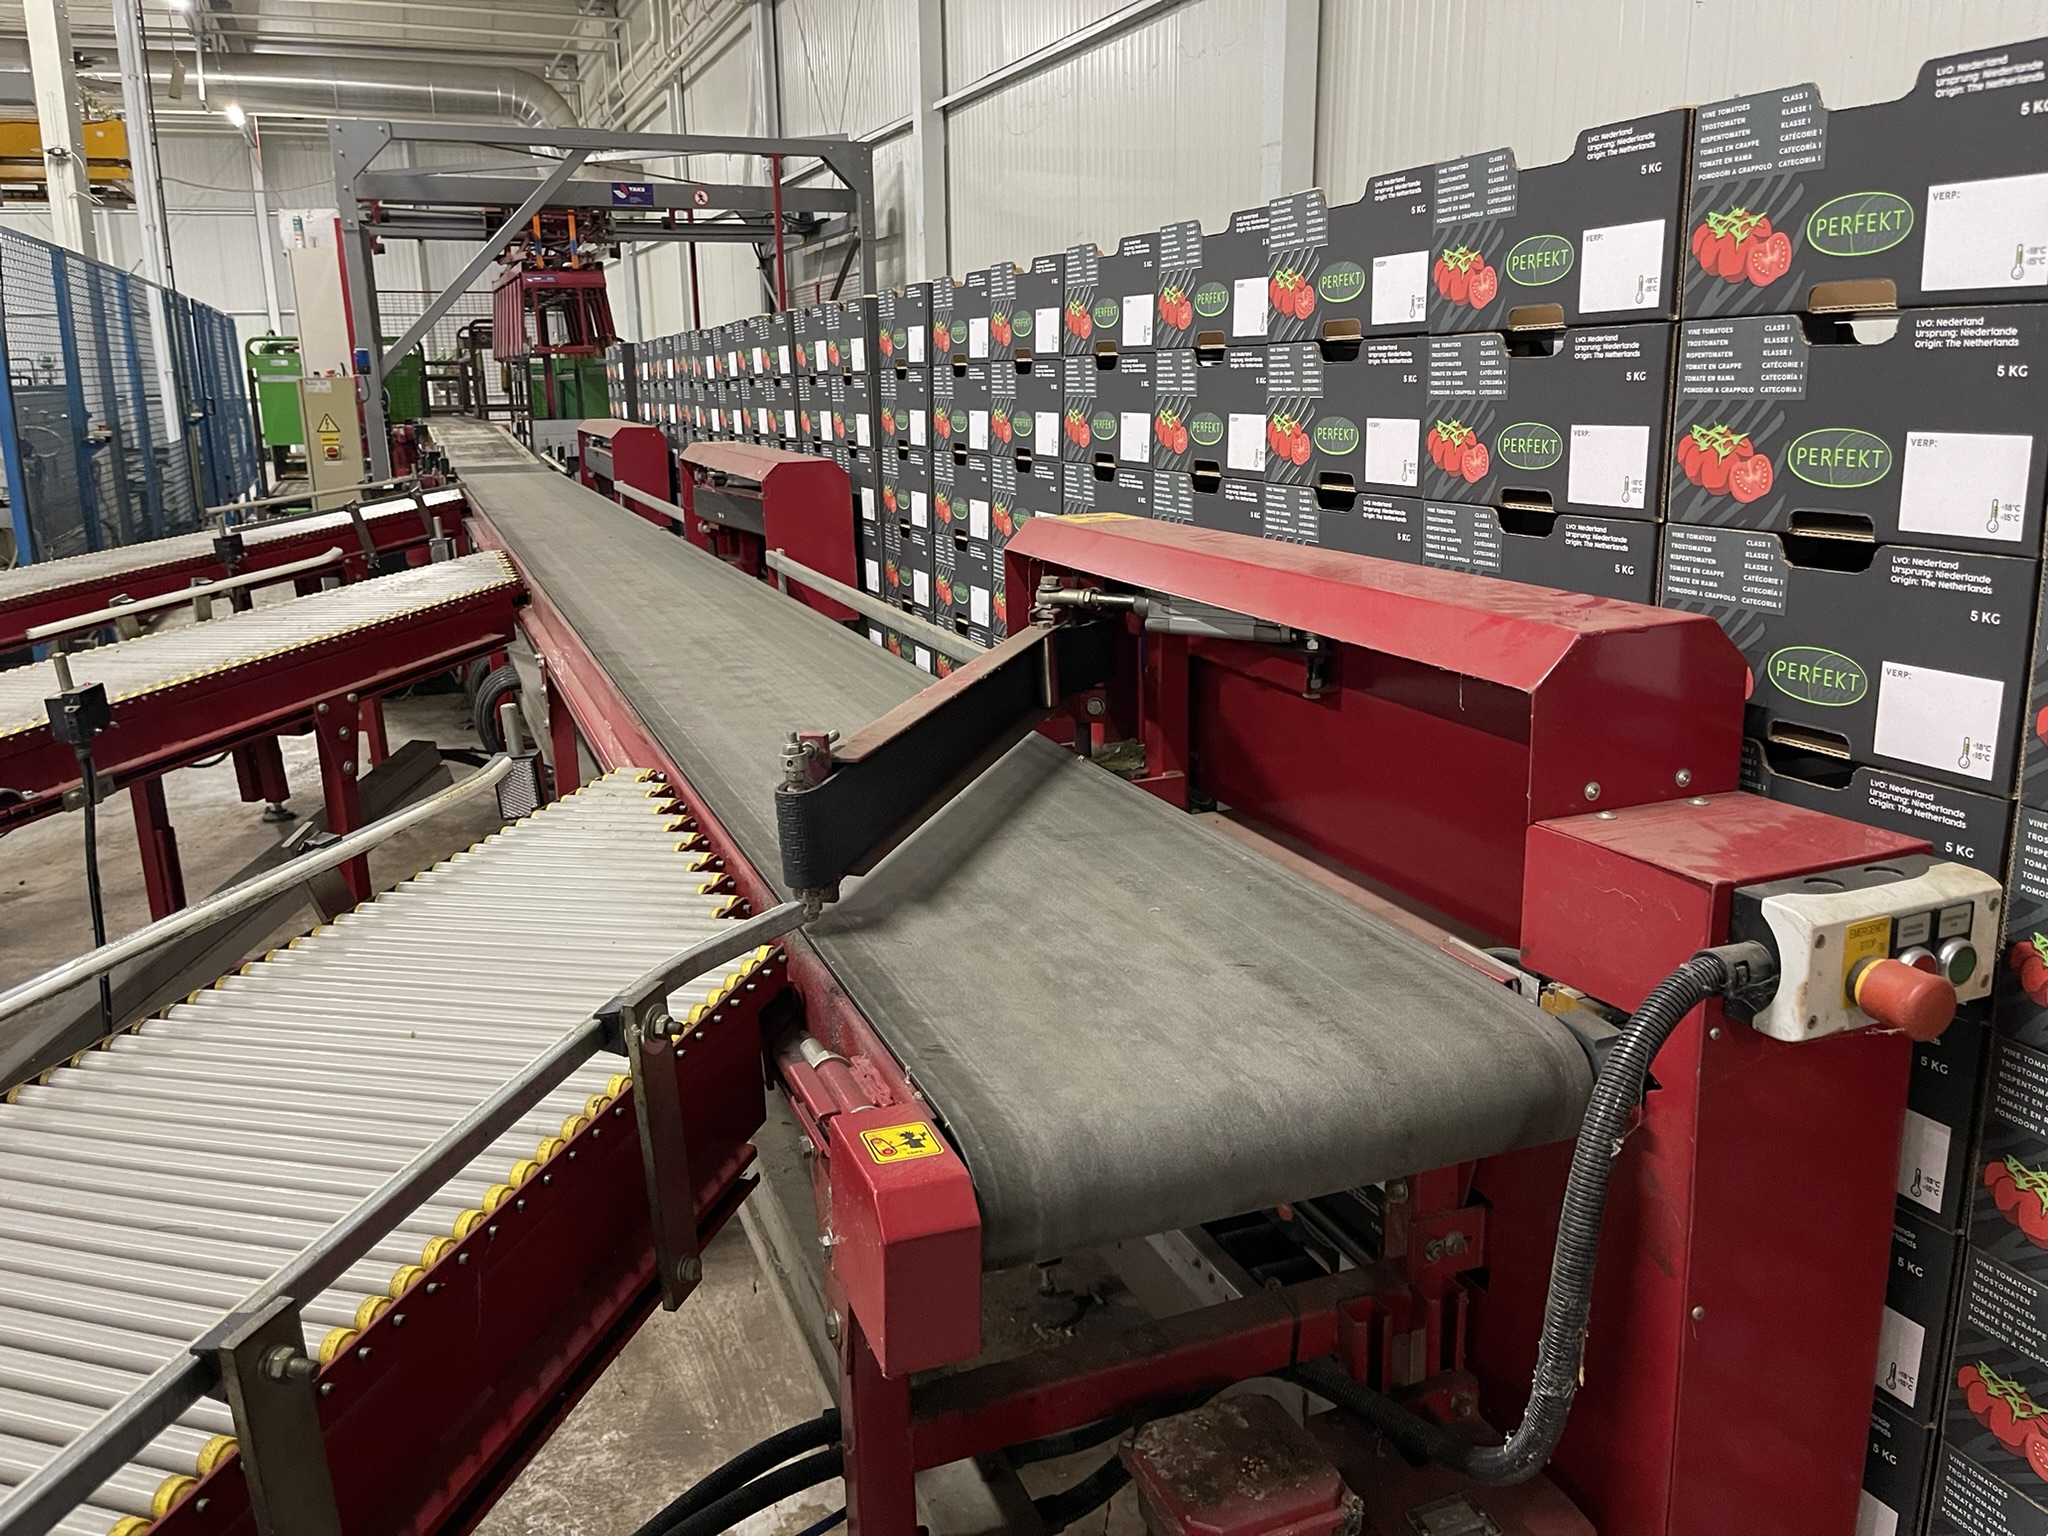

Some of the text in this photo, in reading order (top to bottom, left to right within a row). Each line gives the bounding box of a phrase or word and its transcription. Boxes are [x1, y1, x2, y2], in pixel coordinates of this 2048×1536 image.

[1641, 162, 1662, 175] 5 KG
[1411, 204, 1426, 214] 5 KG
[1816, 209, 1905, 237] PERFEKT
[1512, 249, 1569, 271] PERFEKT
[1320, 271, 1363, 291] PERFEKT
[1196, 291, 1228, 307] PERFEKT
[1093, 306, 1119, 319] PERFEKT
[1936, 316, 1984, 327] Nederland
[1764, 336, 1789, 344] KLASSE
[1915, 327, 2018, 340] Ursprung: Niederlande
[1914, 338, 2019, 350] Origin: The Netherlands
[1626, 371, 1646, 381] 5 KG
[1997, 365, 2028, 377] 5 KG
[1092, 419, 1117, 431] PERFEKT
[1191, 421, 1223, 435] PERFEKT
[1316, 427, 1356, 443] PERFEKT
[1503, 438, 1558, 454] PERFEKT
[1797, 447, 1884, 468] PERFEKT
[1686, 533, 1717, 542] TOMATOES
[1671, 542, 1712, 553] TROSTOMATEN
[1745, 551, 1769, 560] KLASSE
[1670, 553, 1716, 565] RISPENTOMATEN
[1912, 558, 1959, 570] Nederland
[1615, 564, 1634, 575] 5 KG
[1669, 564, 1691, 573] TOMATE
[1701, 569, 1724, 578] GRAPPE
[1744, 563, 1768, 572] KLASSE
[1892, 565, 1991, 584] Ursprung: Niederlande
[1669, 575, 1690, 584] TOMATE
[1890, 575, 1993, 594] Origin: The Netherlands
[1667, 586, 1698, 596] POMODORI
[1704, 592, 1736, 602] GRAPPOLO
[1970, 610, 2000, 625] 5 KG
[1776, 660, 1859, 691] PERFEKT
[1889, 784, 1934, 801] Nederland
[1869, 788, 1965, 819] Ursprung: Niederlande
[1868, 797, 1966, 829] Origin: The Netherlands
[2028, 818, 2048, 830] VINE
[1945, 841, 1974, 858] 5 KG
[1921, 1056, 1948, 1075] 5 KG
[1898, 1257, 1923, 1277] 5 KG
[1976, 1258, 2037, 1297] VINE TOMATOES
[1975, 1269, 2030, 1306] TROSTOMATEN
[1973, 1281, 2036, 1321] RISPENTOMATEN
[1971, 1292, 2047, 1341] TOMATE EN GRAPPE
[1968, 1314, 2009, 1343] POMODORI
[1970, 1303, 2037, 1347] TOMATE EN RAMA
[1873, 1444, 1897, 1465] 5 KG
